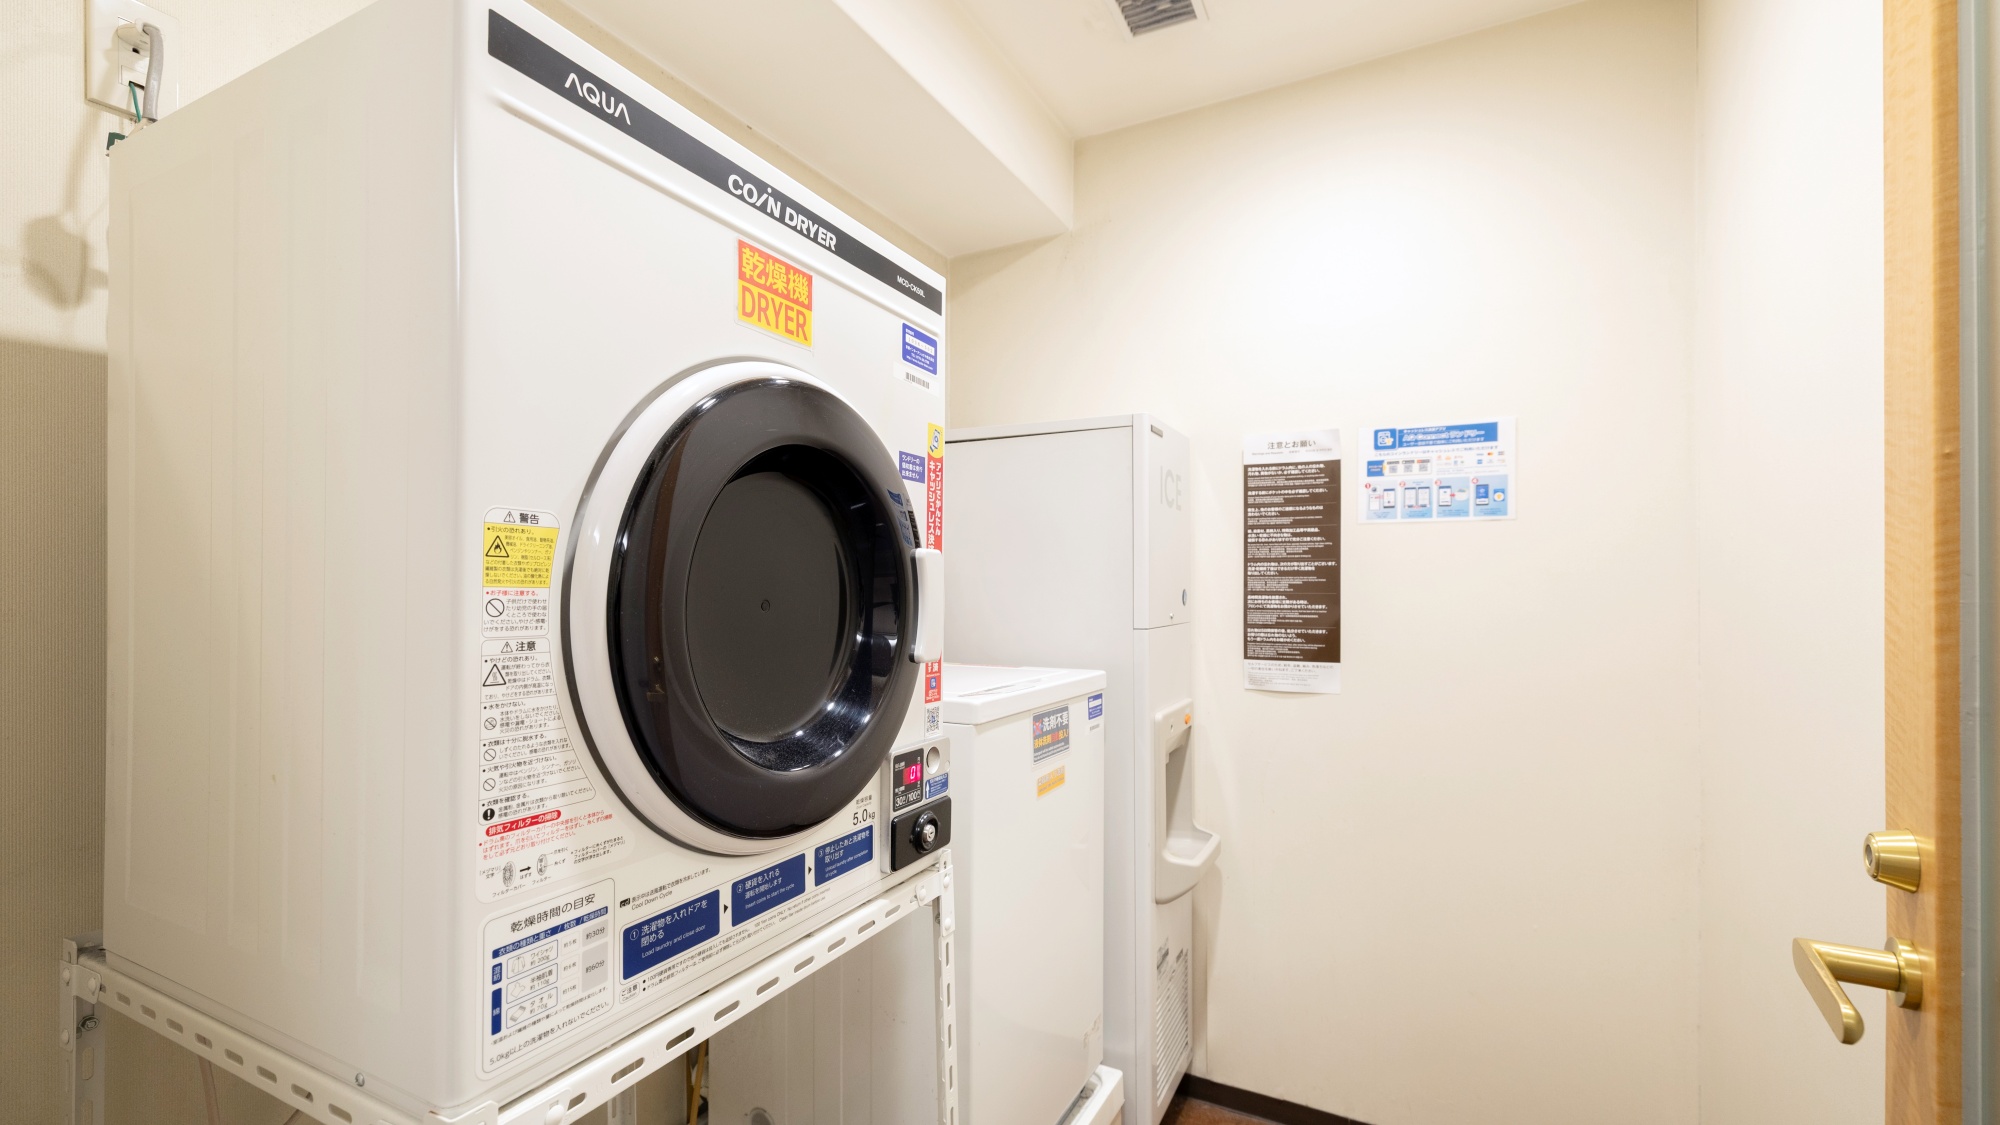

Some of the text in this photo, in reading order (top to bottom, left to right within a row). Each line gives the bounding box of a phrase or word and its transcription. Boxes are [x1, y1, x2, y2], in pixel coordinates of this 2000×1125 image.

[564, 72, 632, 126] AQUA
[785, 208, 837, 251] DRYER
[742, 247, 810, 304] 乾燥機
[741, 288, 808, 342] DRYER
[1268, 440, 1316, 450] 注意とお願い
[1161, 466, 1182, 511] ICE
[519, 513, 540, 525] 警告
[516, 641, 536, 652] 注意
[489, 701, 526, 710] 水をかけない。
[1043, 711, 1068, 732] 洗剤不要
[489, 811, 558, 836] 排気フィルターの掃除
[825, 850, 844, 863] 取り出す
[745, 869, 780, 890] 硬貨を入れる
[745, 877, 782, 900] 運転を開始します
[632, 891, 673, 910] Cool Down Cycle
[746, 901, 756, 910] Insert
[771, 890, 780, 898] start
[510, 894, 596, 934] 乾燥時間の目安
[641, 900, 708, 936] 洗濯物を入れドアを
[499, 929, 552, 957] 衣類の種類と重さ
[586, 927, 605, 940] 約30分
[641, 930, 665, 947] 閉める
[642, 925, 706, 958] Load laundry and close door
[530, 946, 554, 960] ワイシャツ
[586, 960, 605, 973] 約60分
[622, 984, 638, 997] ご注意
